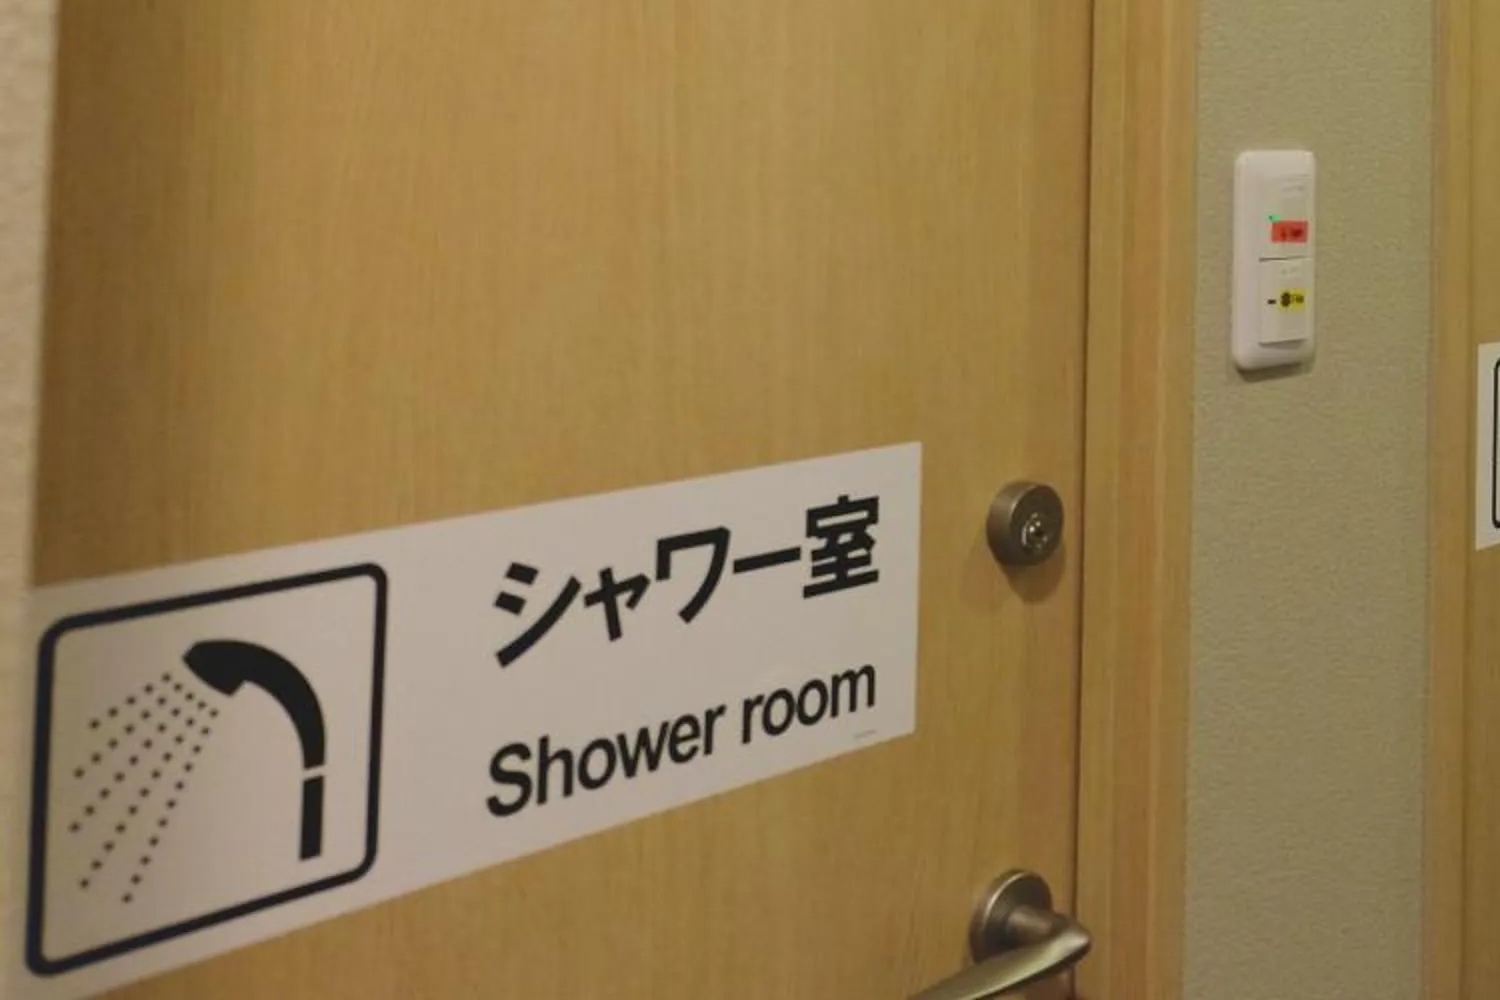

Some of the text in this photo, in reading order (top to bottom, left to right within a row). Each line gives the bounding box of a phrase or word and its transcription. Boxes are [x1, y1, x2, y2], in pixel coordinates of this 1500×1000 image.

[492, 495, 880, 668] シャワー室
[486, 663, 876, 818] Shower room
